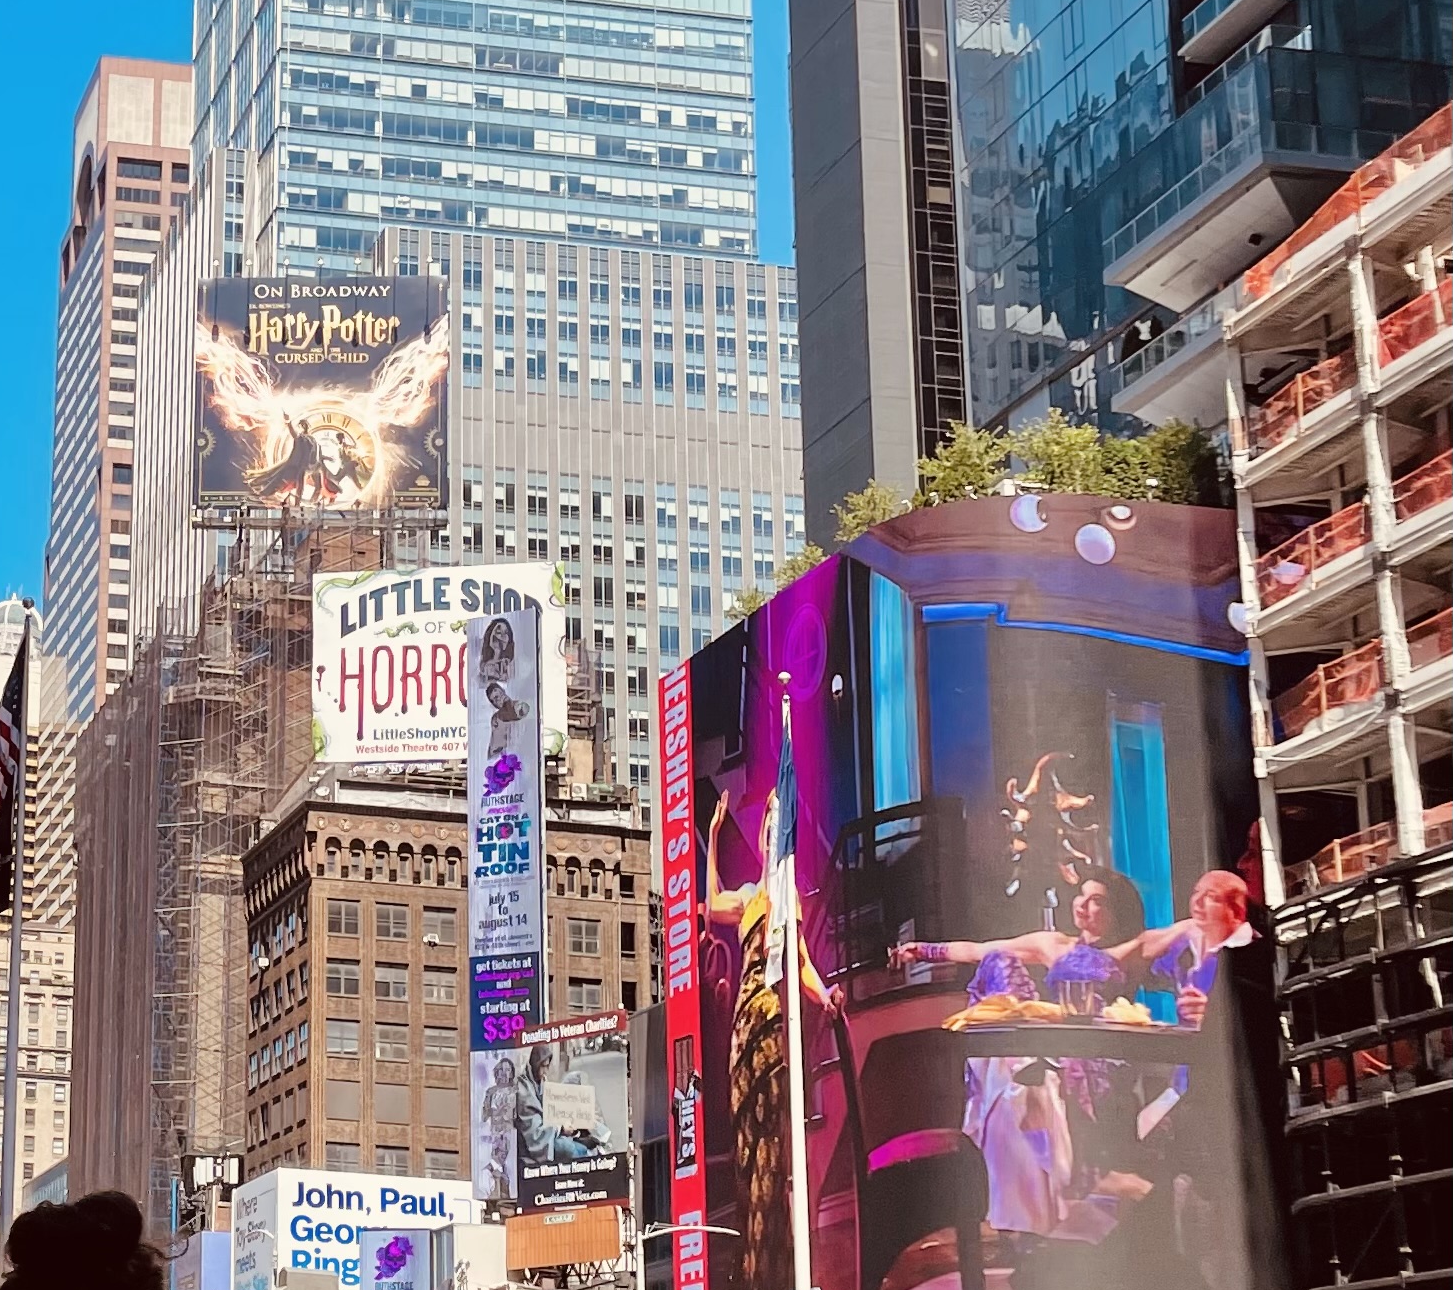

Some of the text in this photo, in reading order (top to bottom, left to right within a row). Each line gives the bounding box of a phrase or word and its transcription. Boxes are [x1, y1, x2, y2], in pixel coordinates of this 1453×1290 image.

[248, 305, 401, 359] Harry Potter
[274, 352, 369, 364] CURSED CHILD
[340, 577, 451, 638] LITTLE
[424, 621, 445, 634] OF
[356, 742, 460, 755] Westside Theatre 407
[480, 815, 501, 824] CAT
[476, 820, 531, 842] HOT
[478, 841, 530, 863] TIN
[474, 862, 530, 878] ROOF
[489, 891, 520, 906] july 15
[498, 904, 509, 915] to
[479, 914, 528, 931] august 14
[667, 868, 692, 998] STORE
[480, 999, 531, 1015] starting at
[521, 1028, 551, 1044] Donating
[552, 1027, 560, 1039] to
[560, 1023, 585, 1037] Veteran
[292, 1181, 454, 1221] John, Paul,
